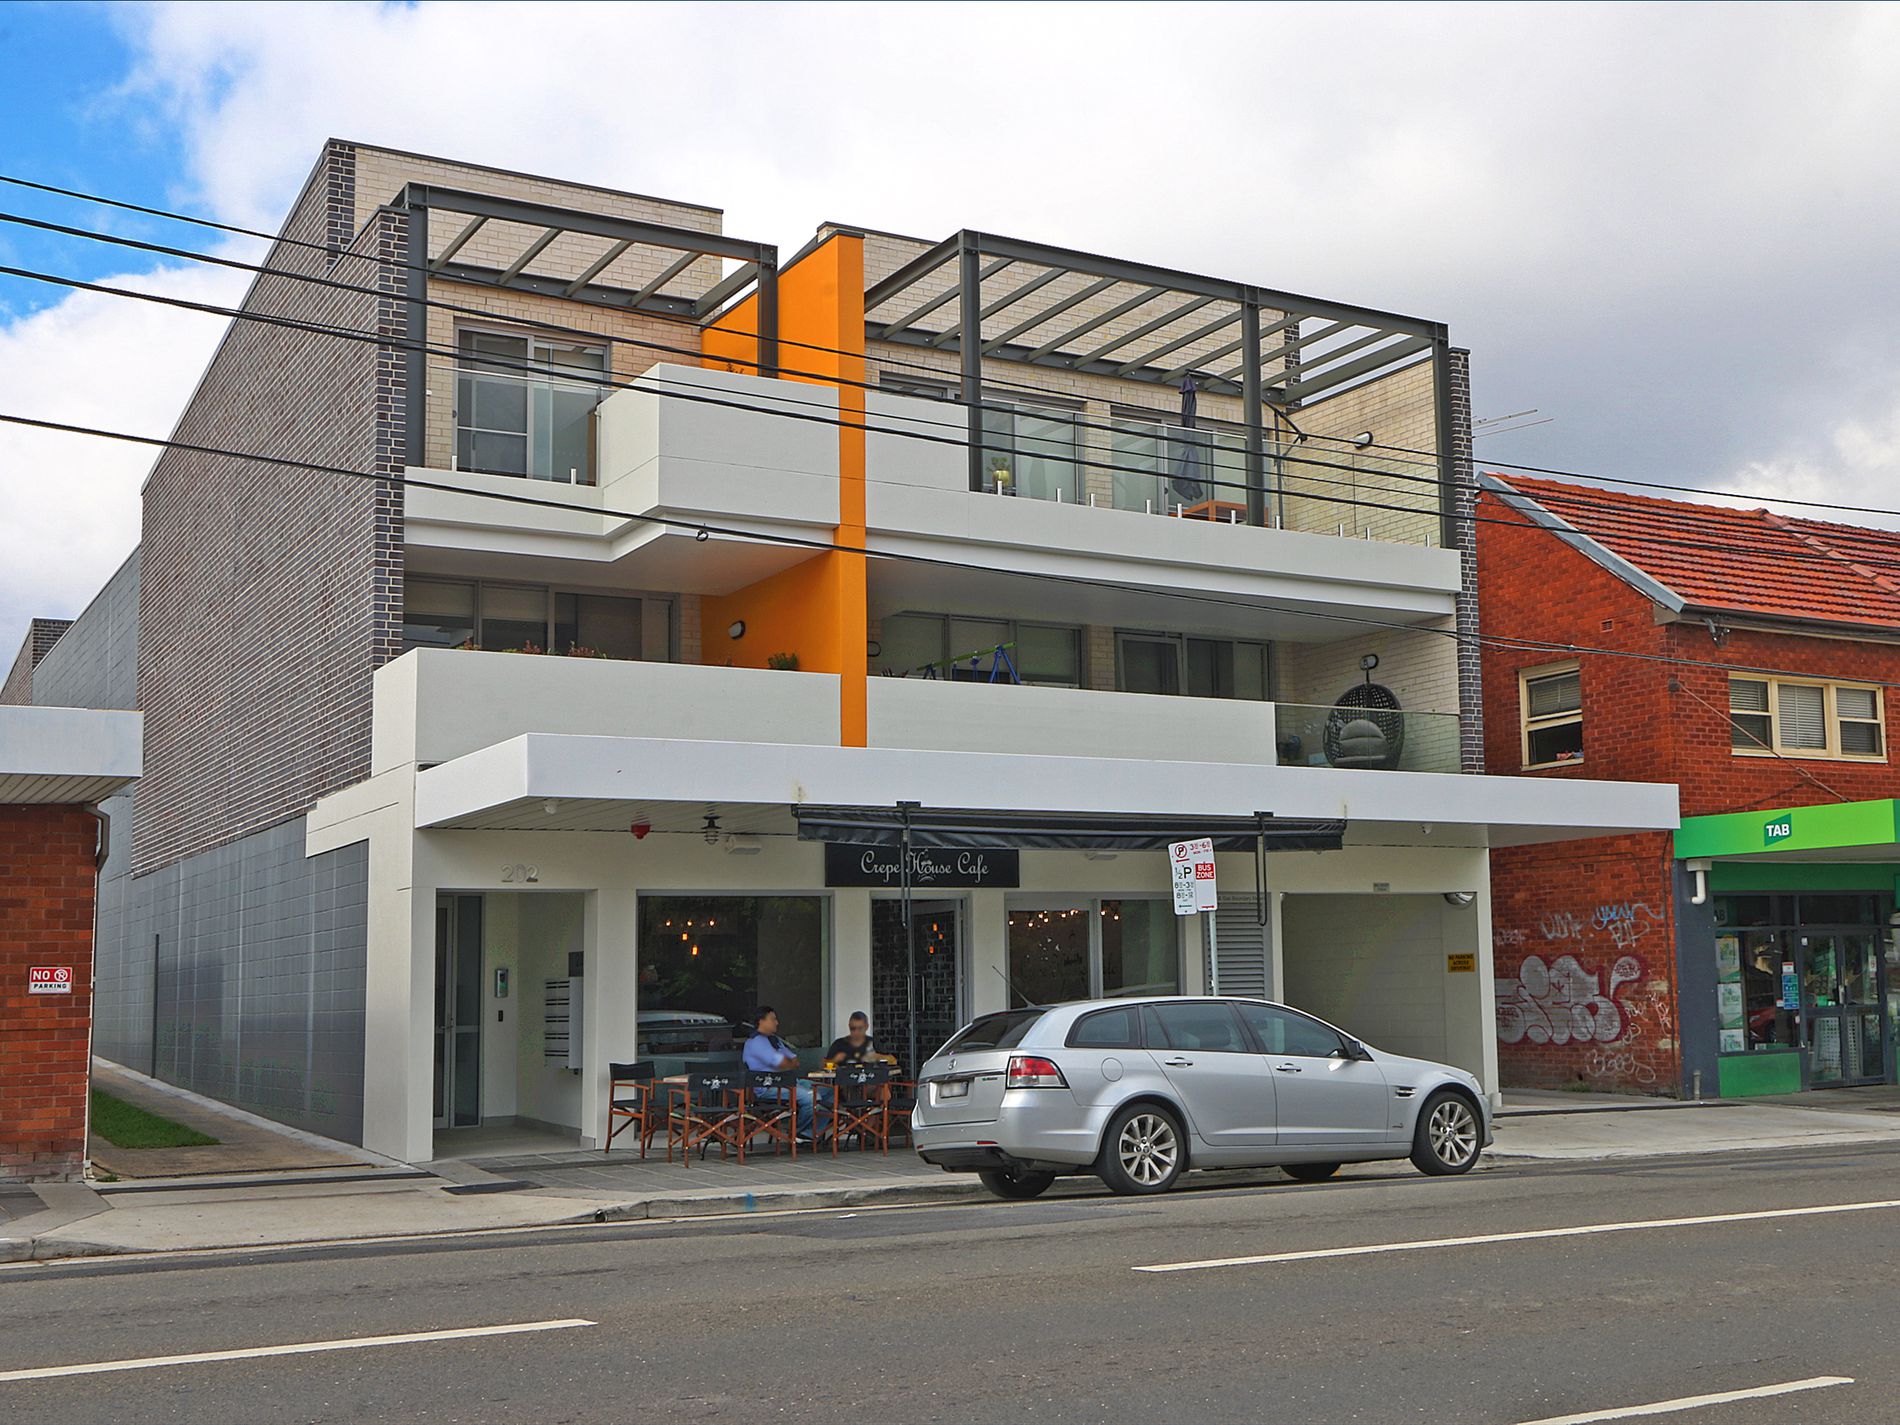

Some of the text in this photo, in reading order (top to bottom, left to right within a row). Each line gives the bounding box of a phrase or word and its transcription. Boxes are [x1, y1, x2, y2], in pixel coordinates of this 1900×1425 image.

[1766, 823, 1790, 837] TAB
[861, 850, 989, 883] Crepe House Cafe
[1197, 864, 1212, 872] BUS
[500, 863, 539, 883] 202
[1196, 871, 1214, 879] ZONE
[33, 970, 50, 981] NO
